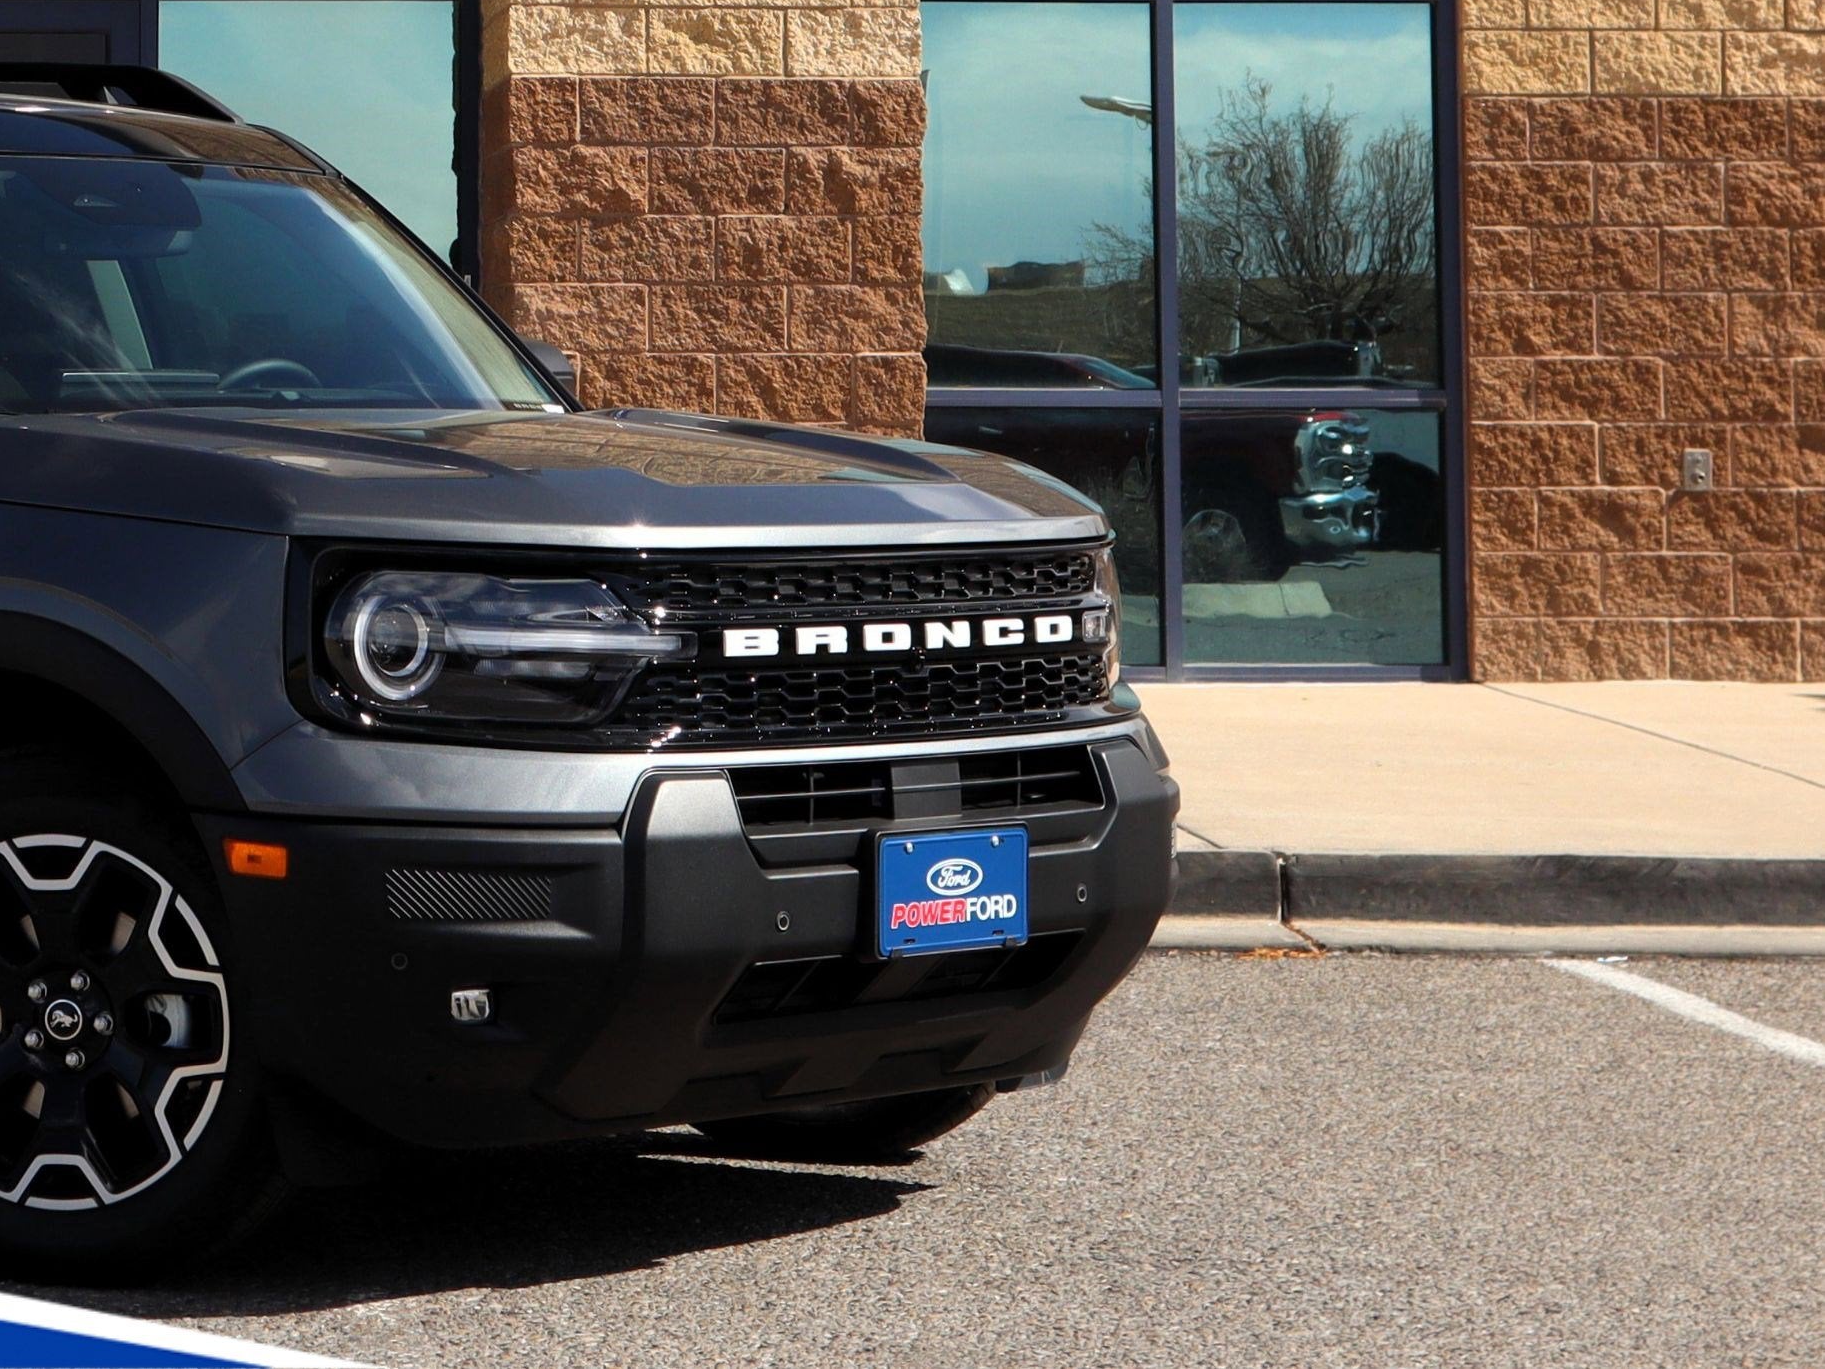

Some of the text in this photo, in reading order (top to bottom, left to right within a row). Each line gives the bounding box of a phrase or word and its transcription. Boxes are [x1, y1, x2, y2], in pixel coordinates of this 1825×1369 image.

[723, 615, 1074, 657] BRONCO
[937, 865, 971, 887] Ford
[891, 894, 1017, 929] POWERFORD
